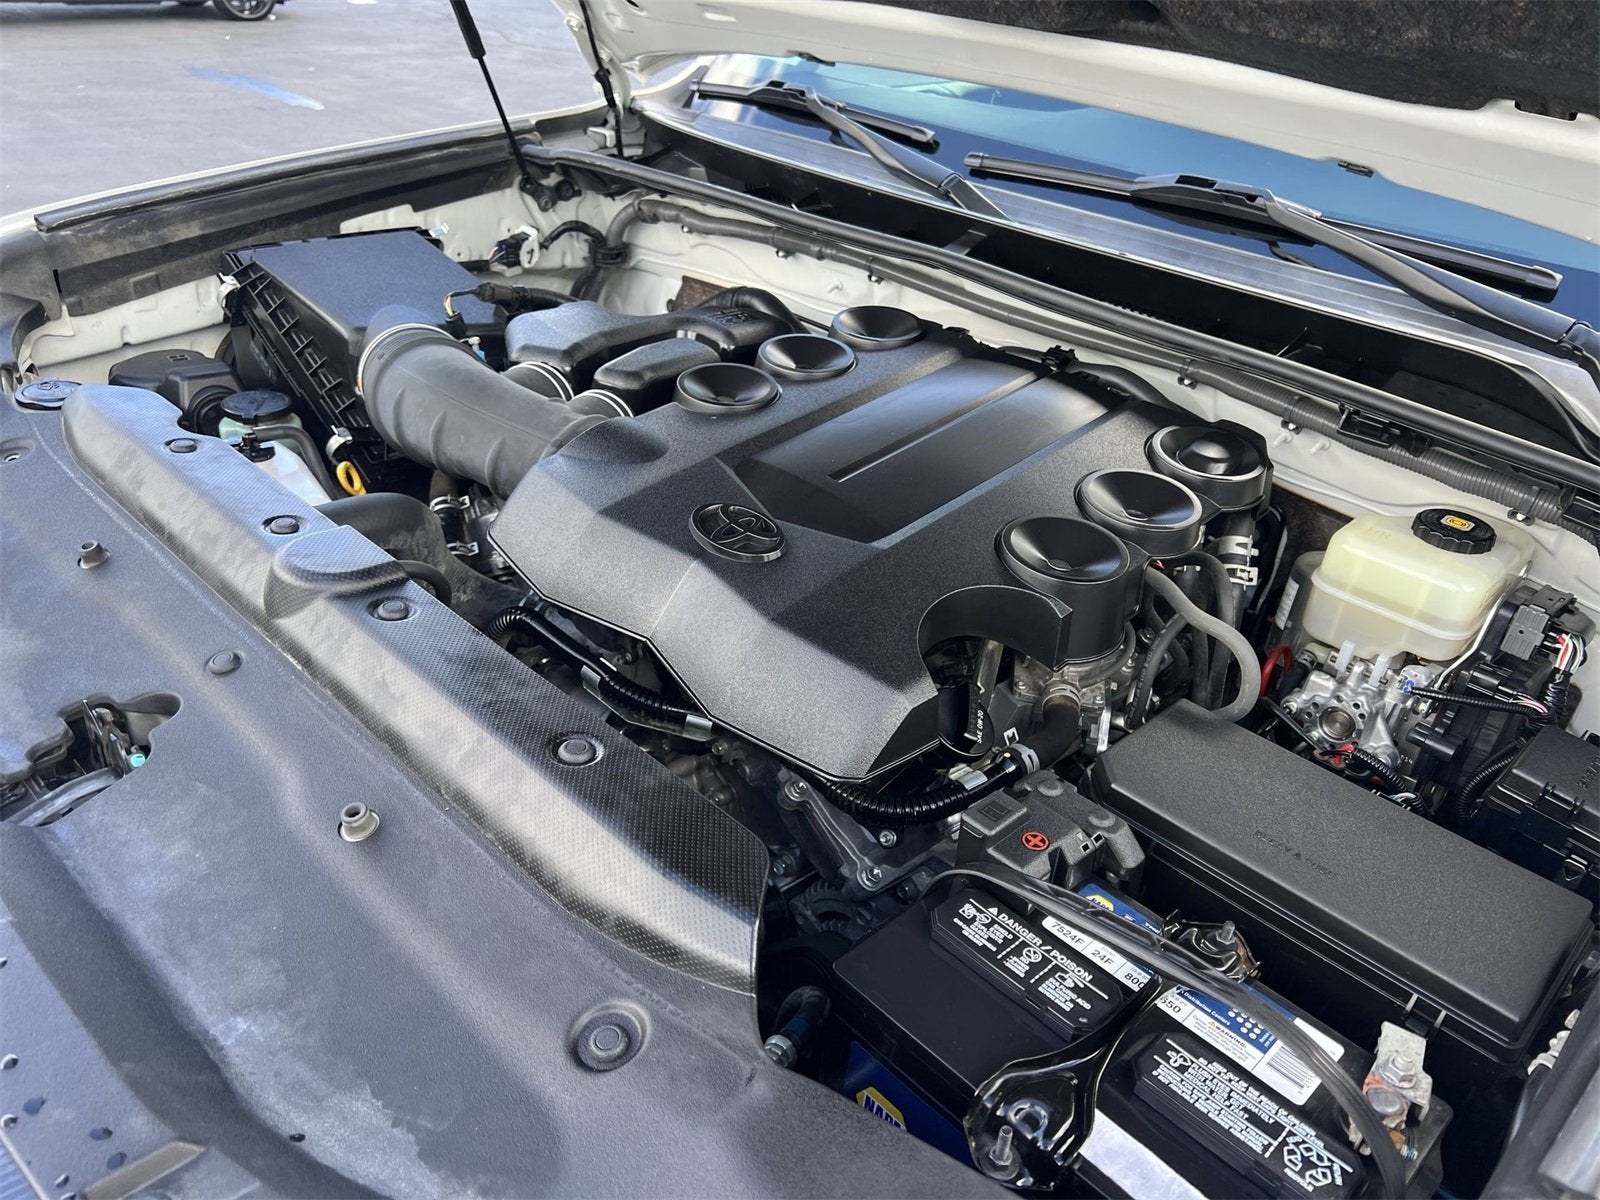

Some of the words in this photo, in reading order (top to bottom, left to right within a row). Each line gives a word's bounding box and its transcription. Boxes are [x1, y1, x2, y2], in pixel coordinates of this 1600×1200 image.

[997, 912, 1043, 946] DANGER
[1049, 950, 1092, 982] POISON
[1050, 921, 1084, 946] 7524F
[1090, 949, 1114, 966] 24F
[1123, 972, 1146, 988] 800
[1183, 991, 1212, 1012] Distribution
[1210, 1010, 1231, 1025] Centers
[1182, 1071, 1212, 1093] MEDICAL
[1211, 1092, 1231, 1106] HELP
[1229, 1105, 1249, 1119] FAST
[1186, 1068, 1205, 1081] WITH
[1229, 1097, 1245, 1109] GET
[1190, 1063, 1214, 1080] FLUSH
[1211, 1078, 1230, 1092] EYES
[1228, 1091, 1276, 1124] IMMEDIATELY
